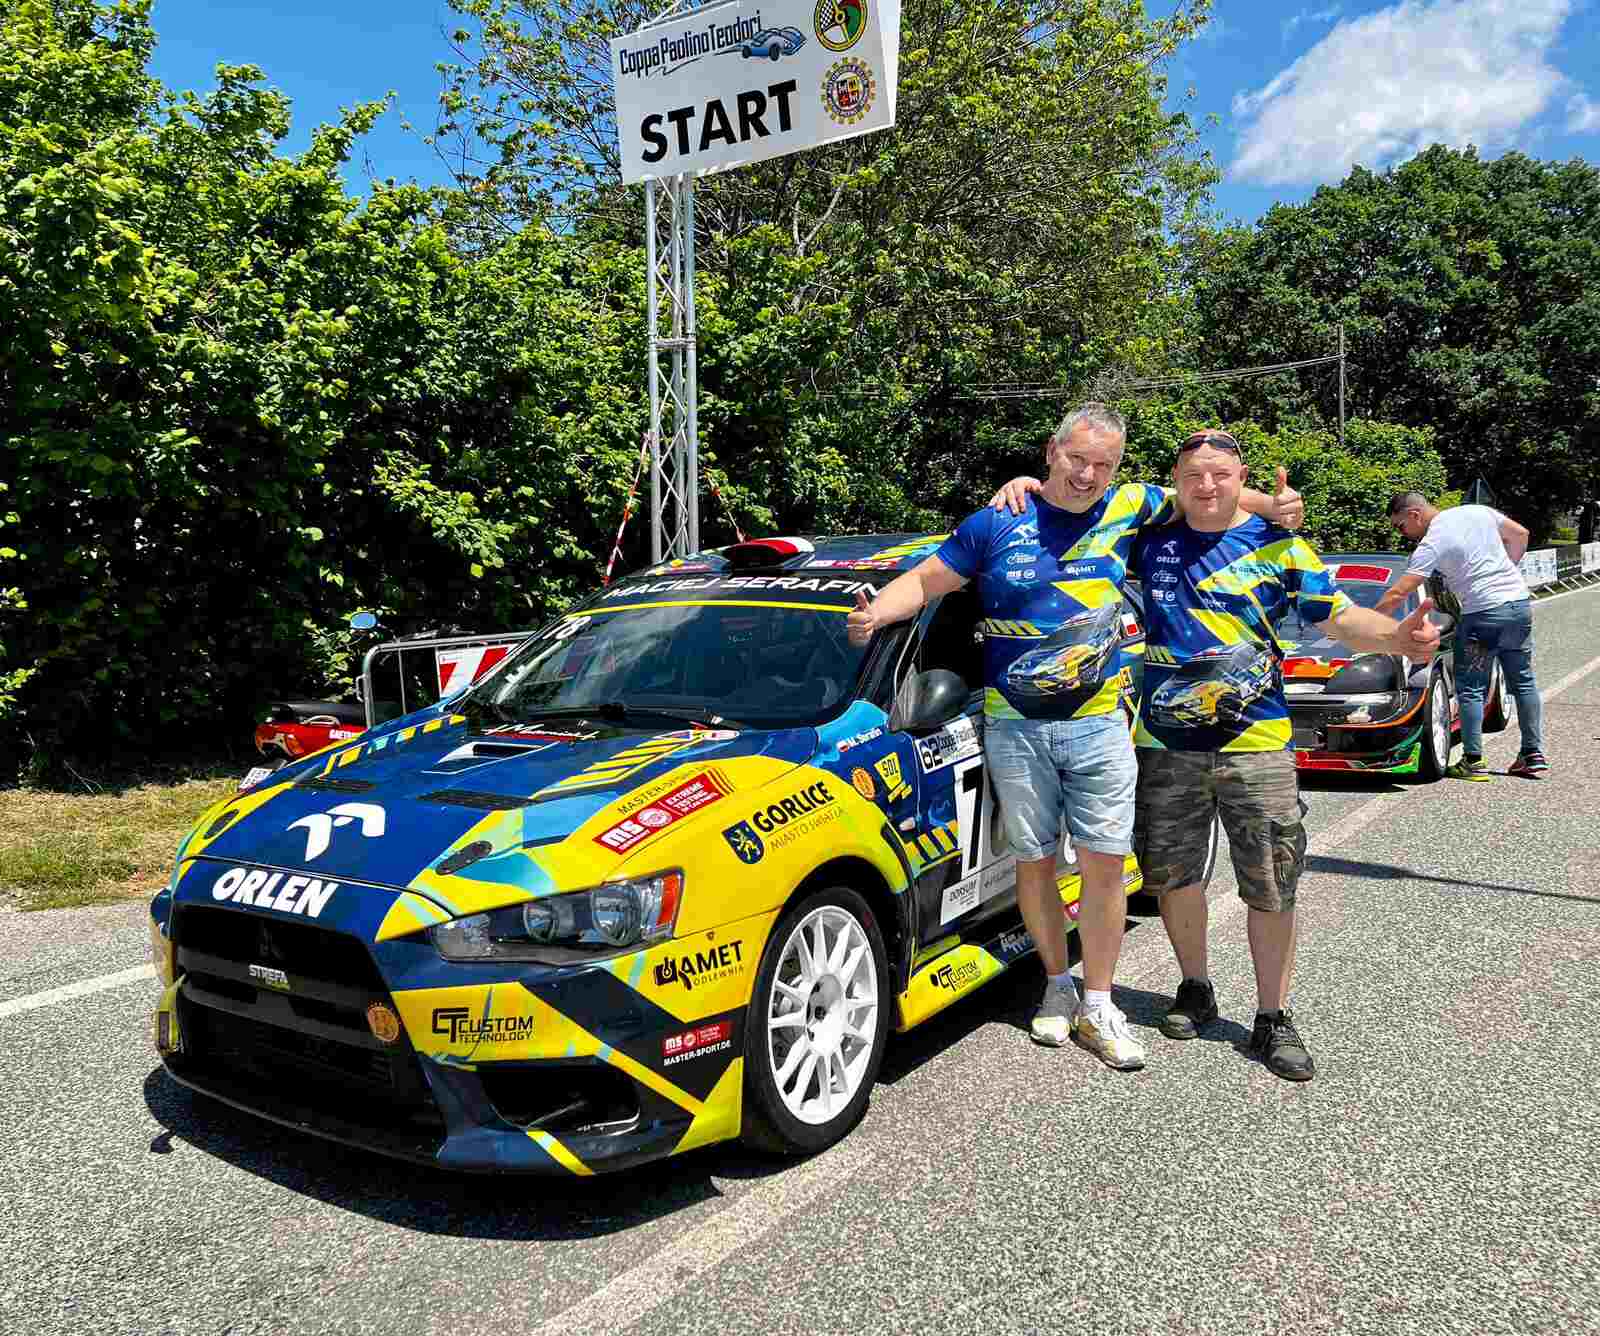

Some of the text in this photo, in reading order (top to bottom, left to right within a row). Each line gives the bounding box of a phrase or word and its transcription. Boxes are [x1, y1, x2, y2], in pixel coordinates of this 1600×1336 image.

[640, 79, 798, 163] START
[602, 576, 721, 600] MACIEJ
[919, 736, 944, 770] 62
[752, 781, 835, 833] GORLICE
[212, 867, 340, 918] ORLEN
[248, 963, 289, 984] STREFA
[458, 1015, 534, 1034] CUSTOM
[459, 1030, 534, 1045] TECHNOLOGY
